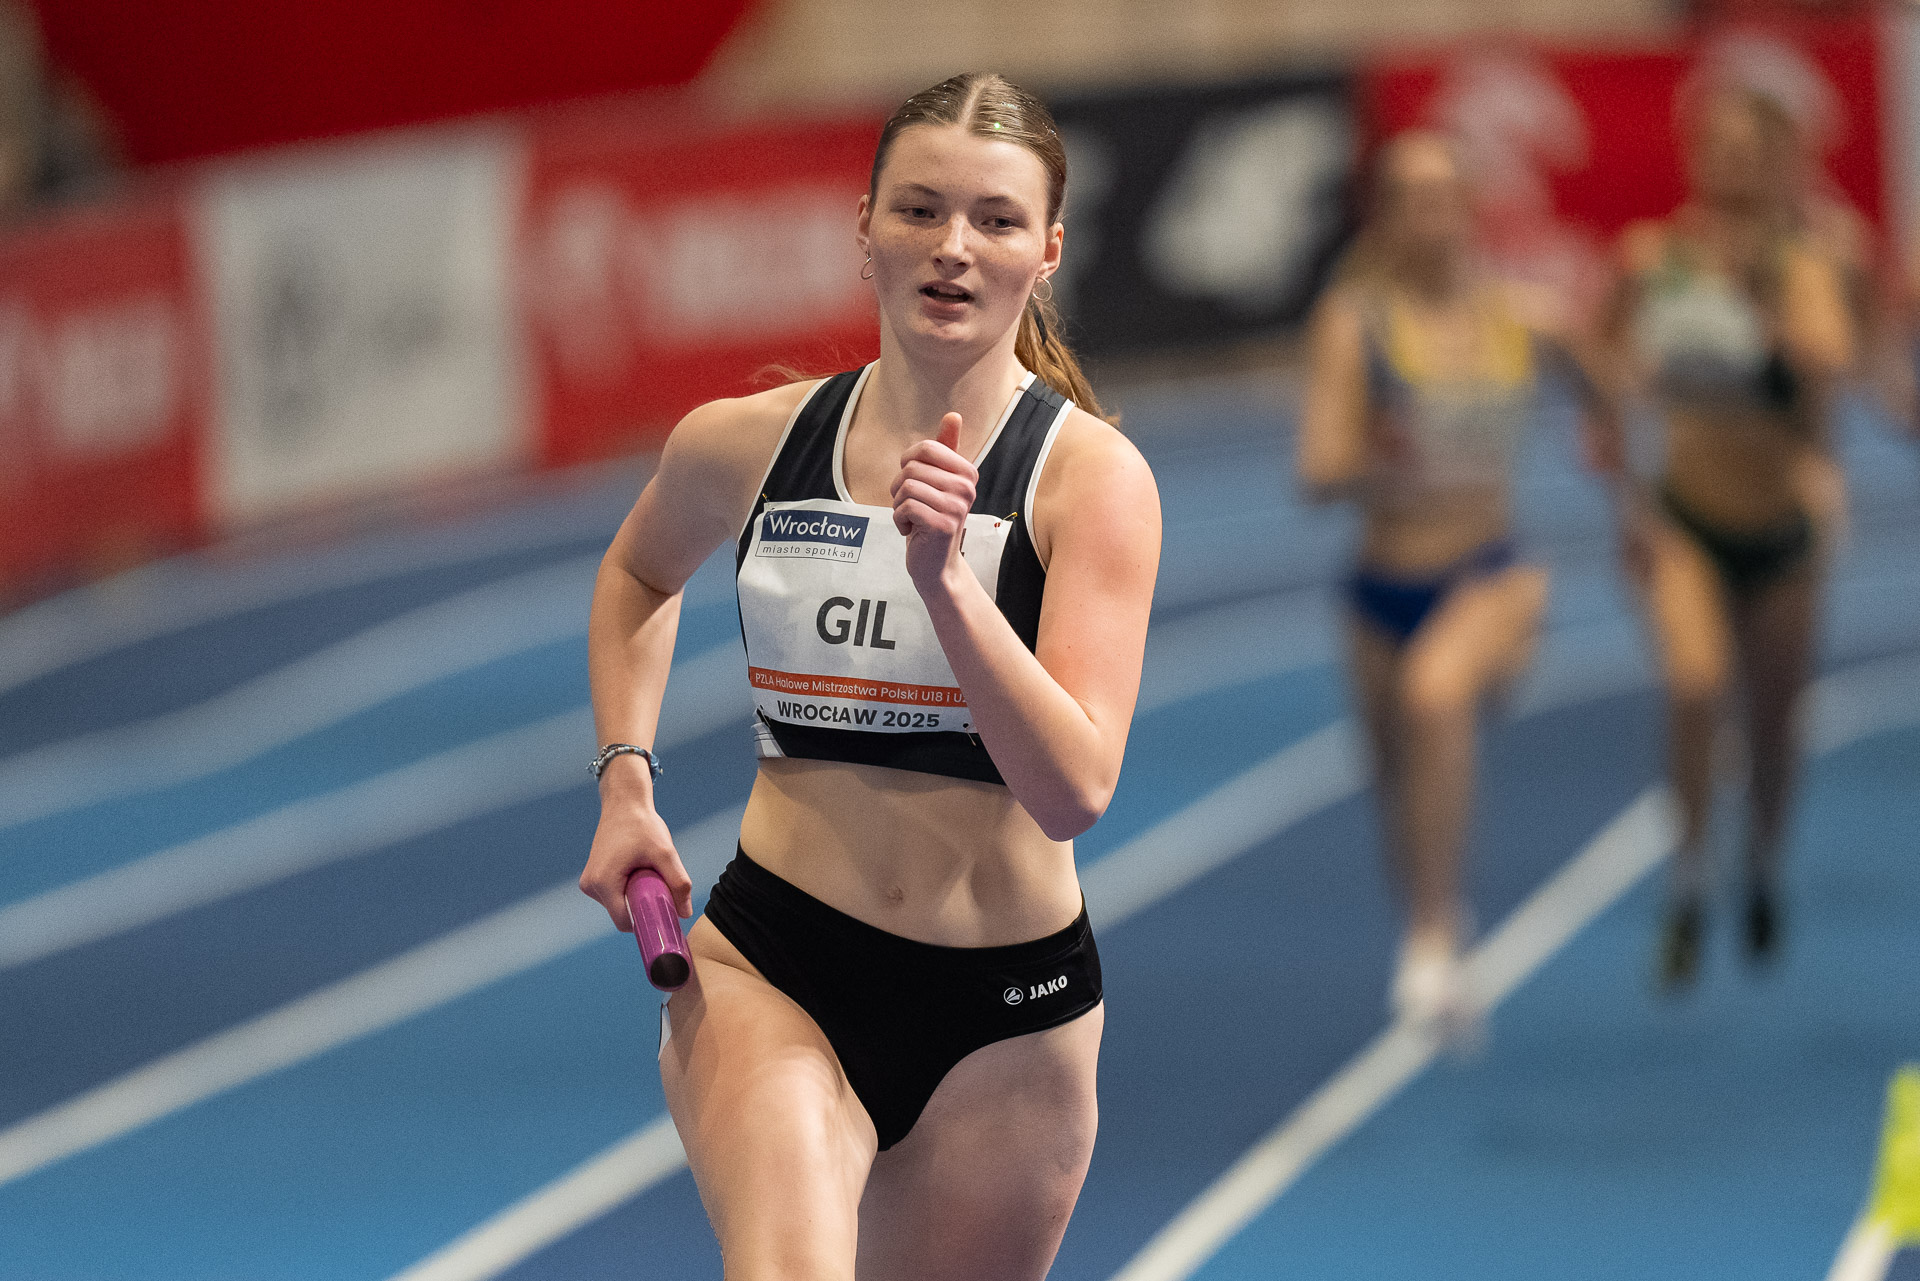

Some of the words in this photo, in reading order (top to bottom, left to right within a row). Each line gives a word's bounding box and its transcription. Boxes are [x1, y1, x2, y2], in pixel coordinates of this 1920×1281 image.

[770, 515, 861, 540] Wrocław
[763, 545, 800, 554] miasto
[805, 546, 854, 559] spotkań
[816, 596, 896, 650] GIL
[755, 673, 774, 687] PZLA
[775, 676, 809, 691] Halowe
[812, 680, 877, 697] Mistrzostwa
[880, 686, 918, 701] Polski
[921, 689, 943, 702] U18
[953, 692, 967, 703] U
[777, 701, 877, 726] WROCŁAW
[883, 711, 940, 728] 2025
[1029, 975, 1068, 1000] JAKO
